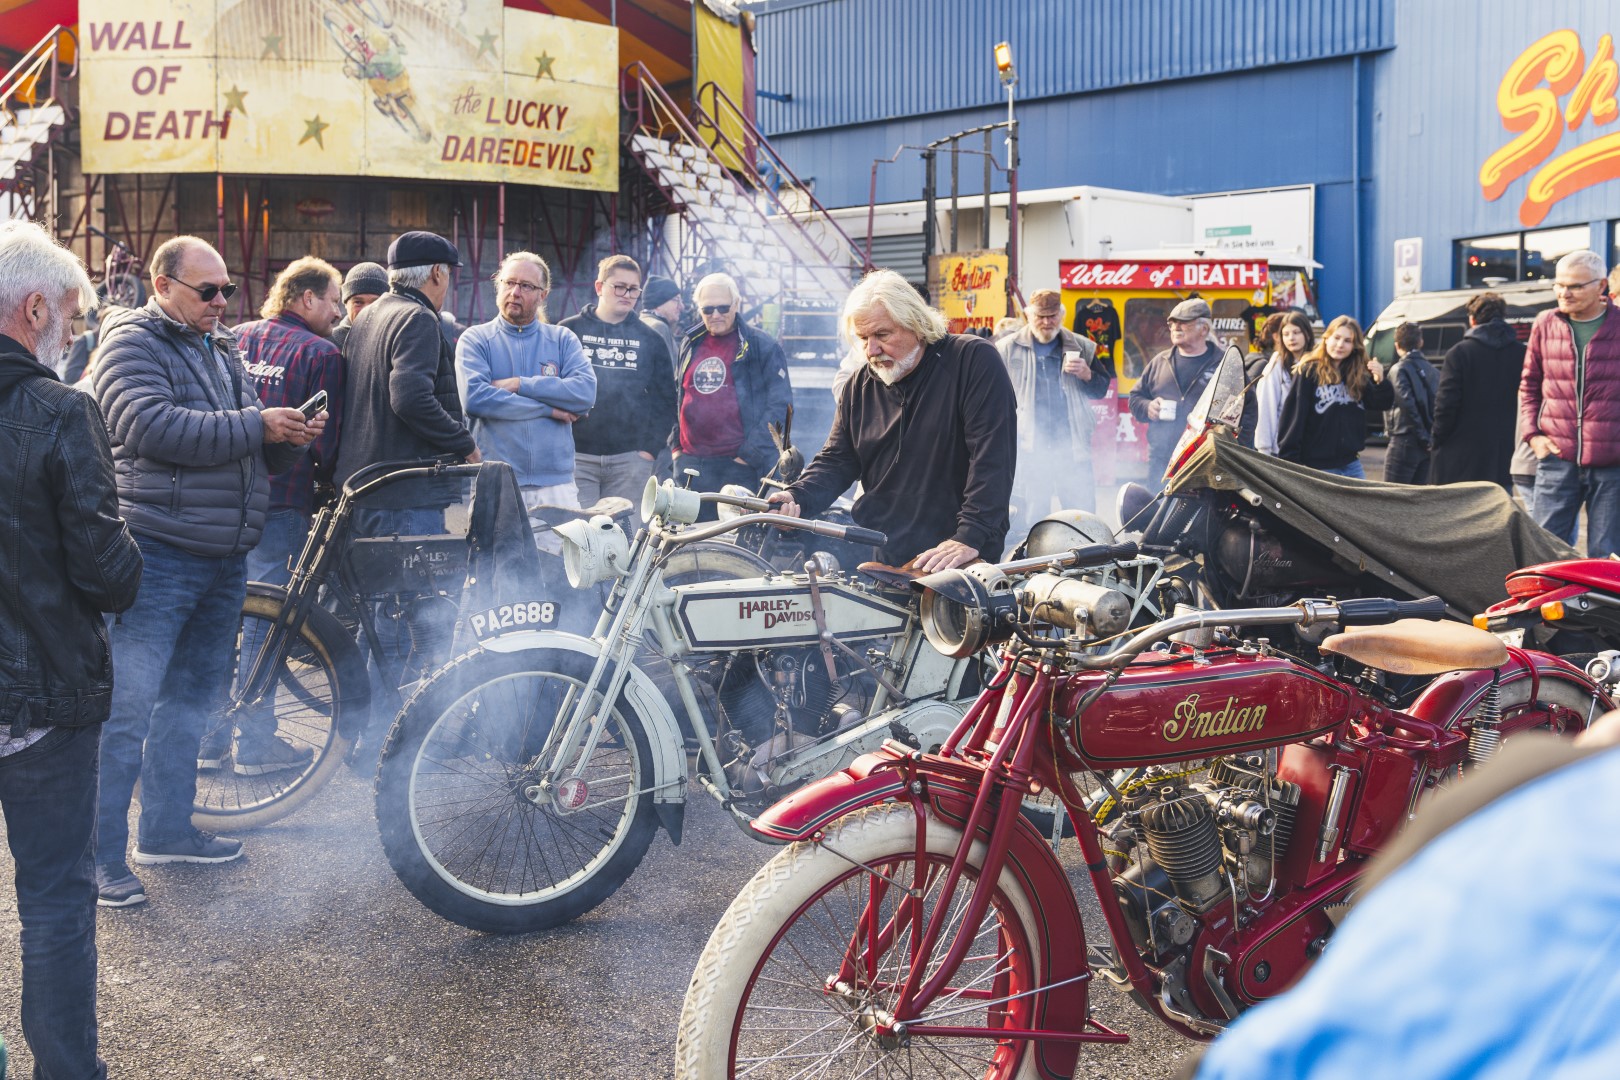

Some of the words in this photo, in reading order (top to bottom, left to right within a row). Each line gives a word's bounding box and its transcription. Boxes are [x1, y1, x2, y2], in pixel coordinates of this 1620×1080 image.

[89, 20, 192, 51] WALL
[131, 65, 182, 96] OF
[454, 86, 482, 115] the
[486, 97, 569, 131] LUCKY
[103, 109, 232, 141] DEATH
[441, 135, 595, 174] DAREDEVILS
[1401, 244, 1414, 266] P
[1070, 264, 1140, 286] Wall
[1149, 265, 1175, 288] of
[1183, 263, 1261, 286] DEATH
[1253, 550, 1293, 568] Indian
[470, 601, 555, 637] PA2688
[739, 599, 799, 620] HARLEY-
[1163, 693, 1267, 742] Indian
